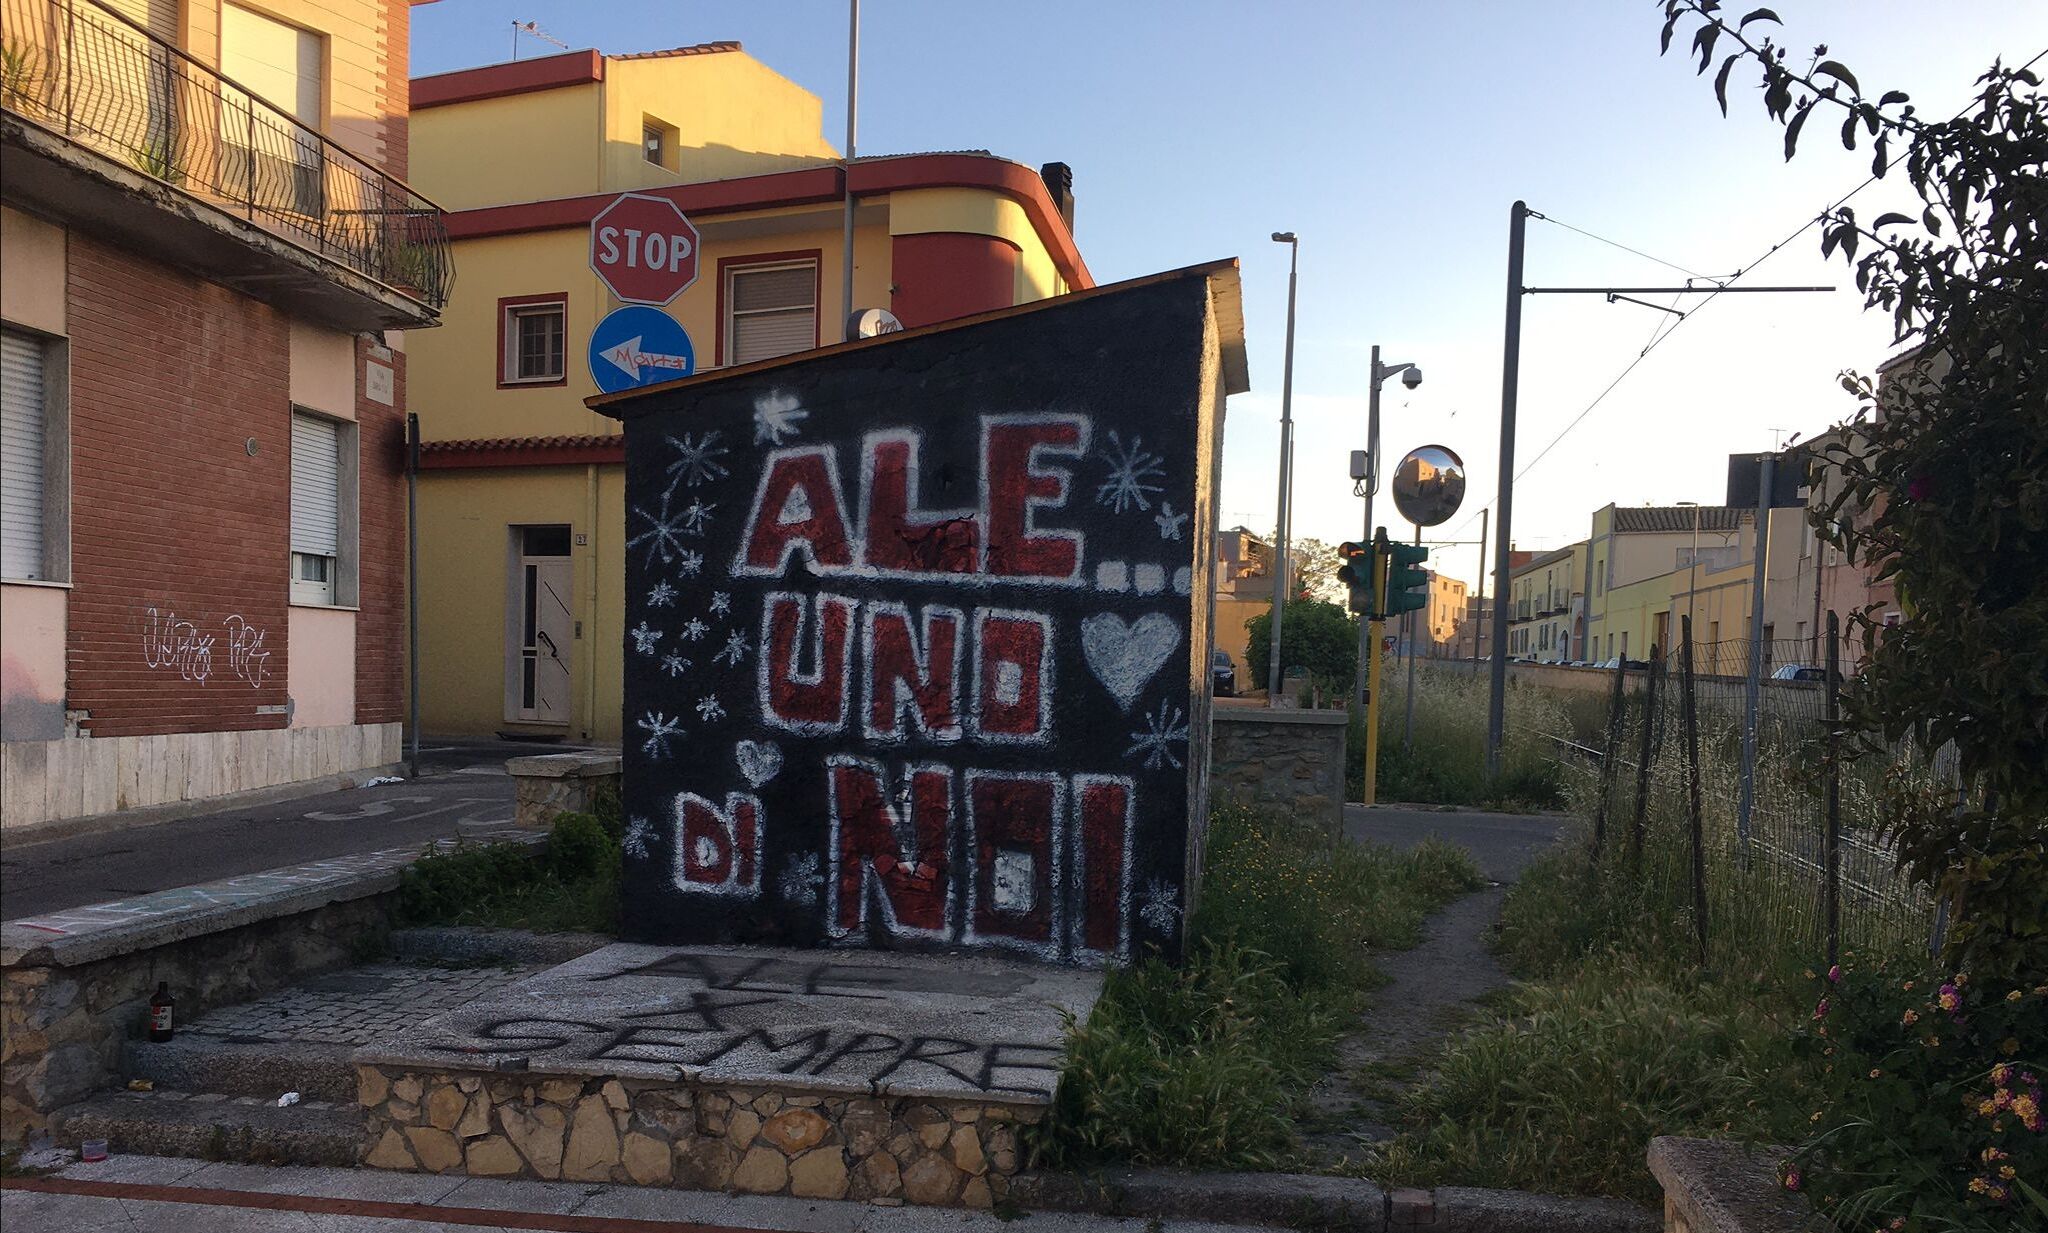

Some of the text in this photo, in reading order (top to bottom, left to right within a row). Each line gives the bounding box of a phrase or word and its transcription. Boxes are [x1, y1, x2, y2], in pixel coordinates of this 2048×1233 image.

[599, 226, 692, 273] STOP
[758, 592, 1055, 743] UNO
[675, 753, 1136, 968] DI NOI
[586, 953, 900, 1000] ALE
[427, 1017, 1064, 1095] SEMPRE
